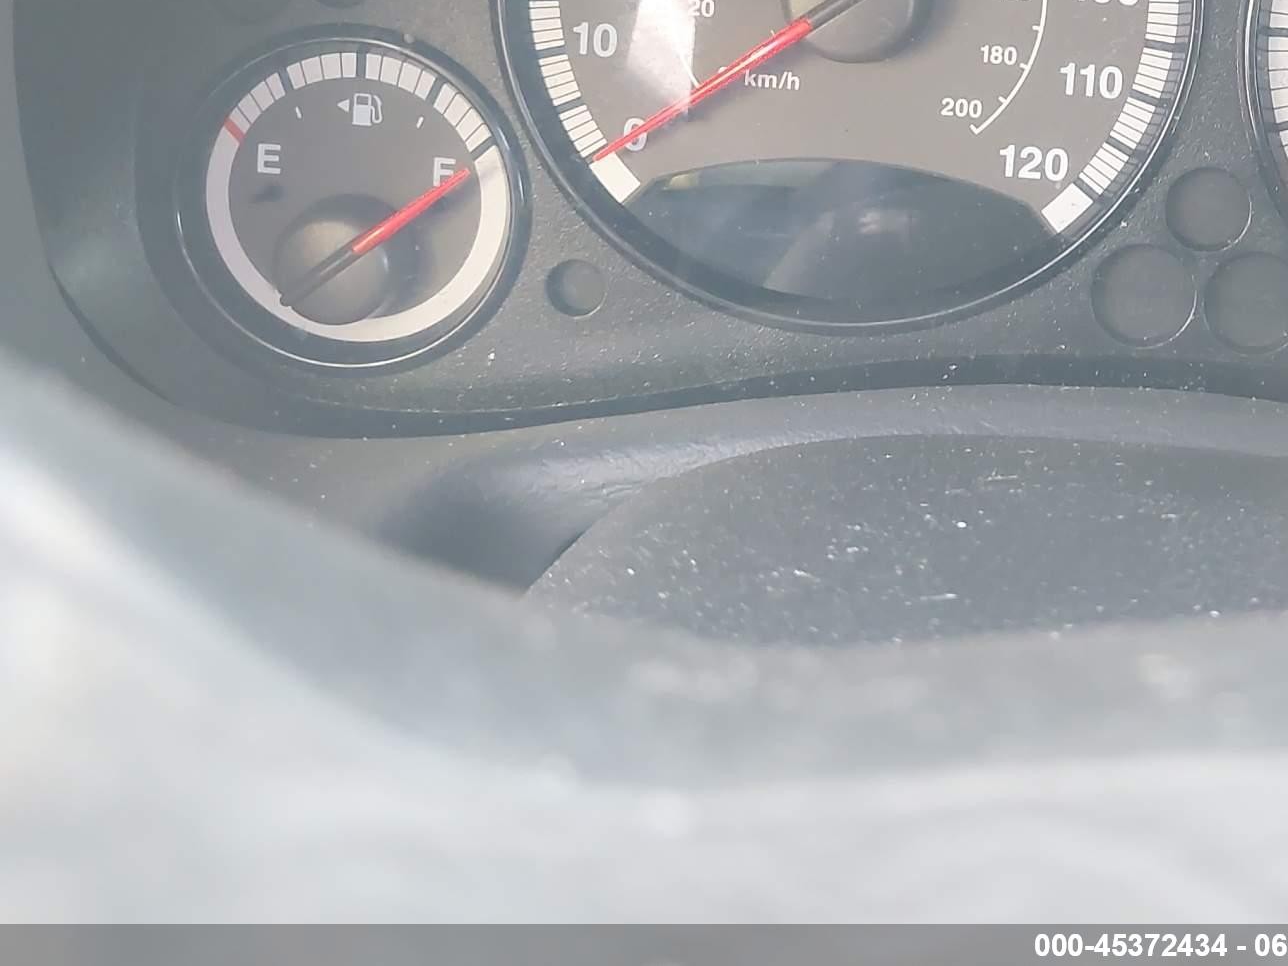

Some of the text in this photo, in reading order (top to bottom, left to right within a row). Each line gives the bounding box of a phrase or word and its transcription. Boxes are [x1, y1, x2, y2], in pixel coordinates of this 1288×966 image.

[573, 21, 618, 58] 10
[980, 44, 1018, 66] 180
[744, 69, 800, 91] km/h
[1060, 62, 1124, 100] 110
[940, 97, 982, 119] 200
[623, 117, 648, 152] 0
[257, 143, 282, 175] E
[432, 156, 456, 187] F
[999, 144, 1069, 182] 120
